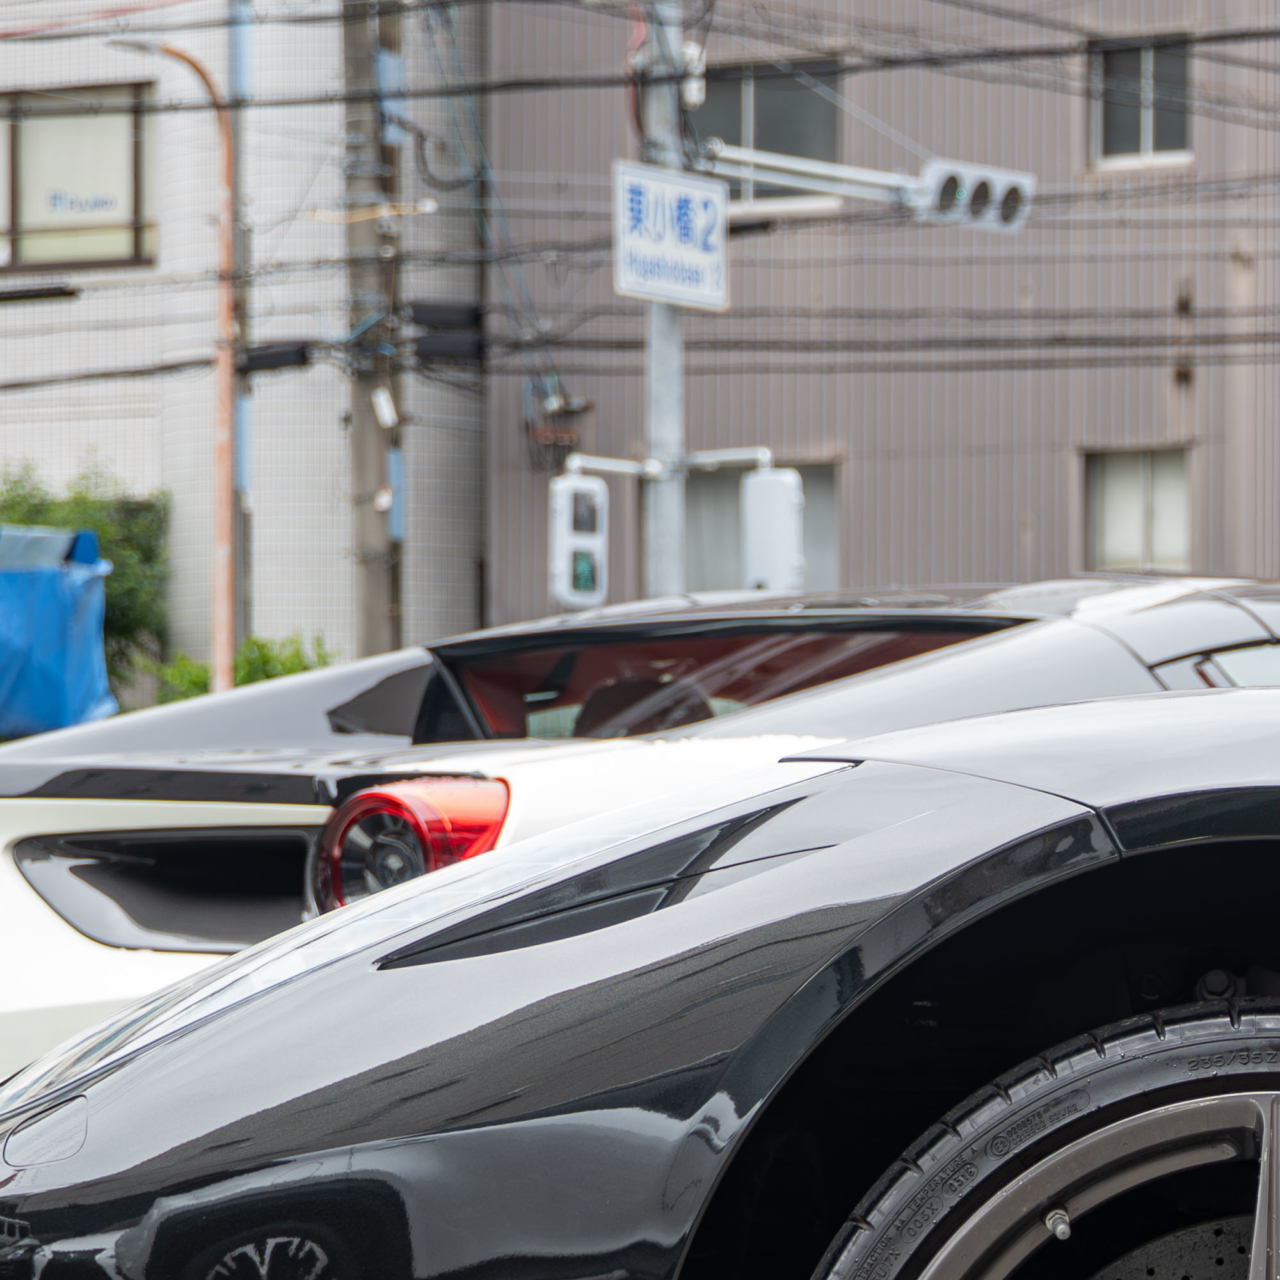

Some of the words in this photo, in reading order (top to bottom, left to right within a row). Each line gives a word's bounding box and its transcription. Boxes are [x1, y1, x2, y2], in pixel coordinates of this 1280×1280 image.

[856, 1233, 892, 1280] TRACTION
[891, 1215, 906, 1231] AA
[905, 1152, 967, 1213] TEMPERATURE
